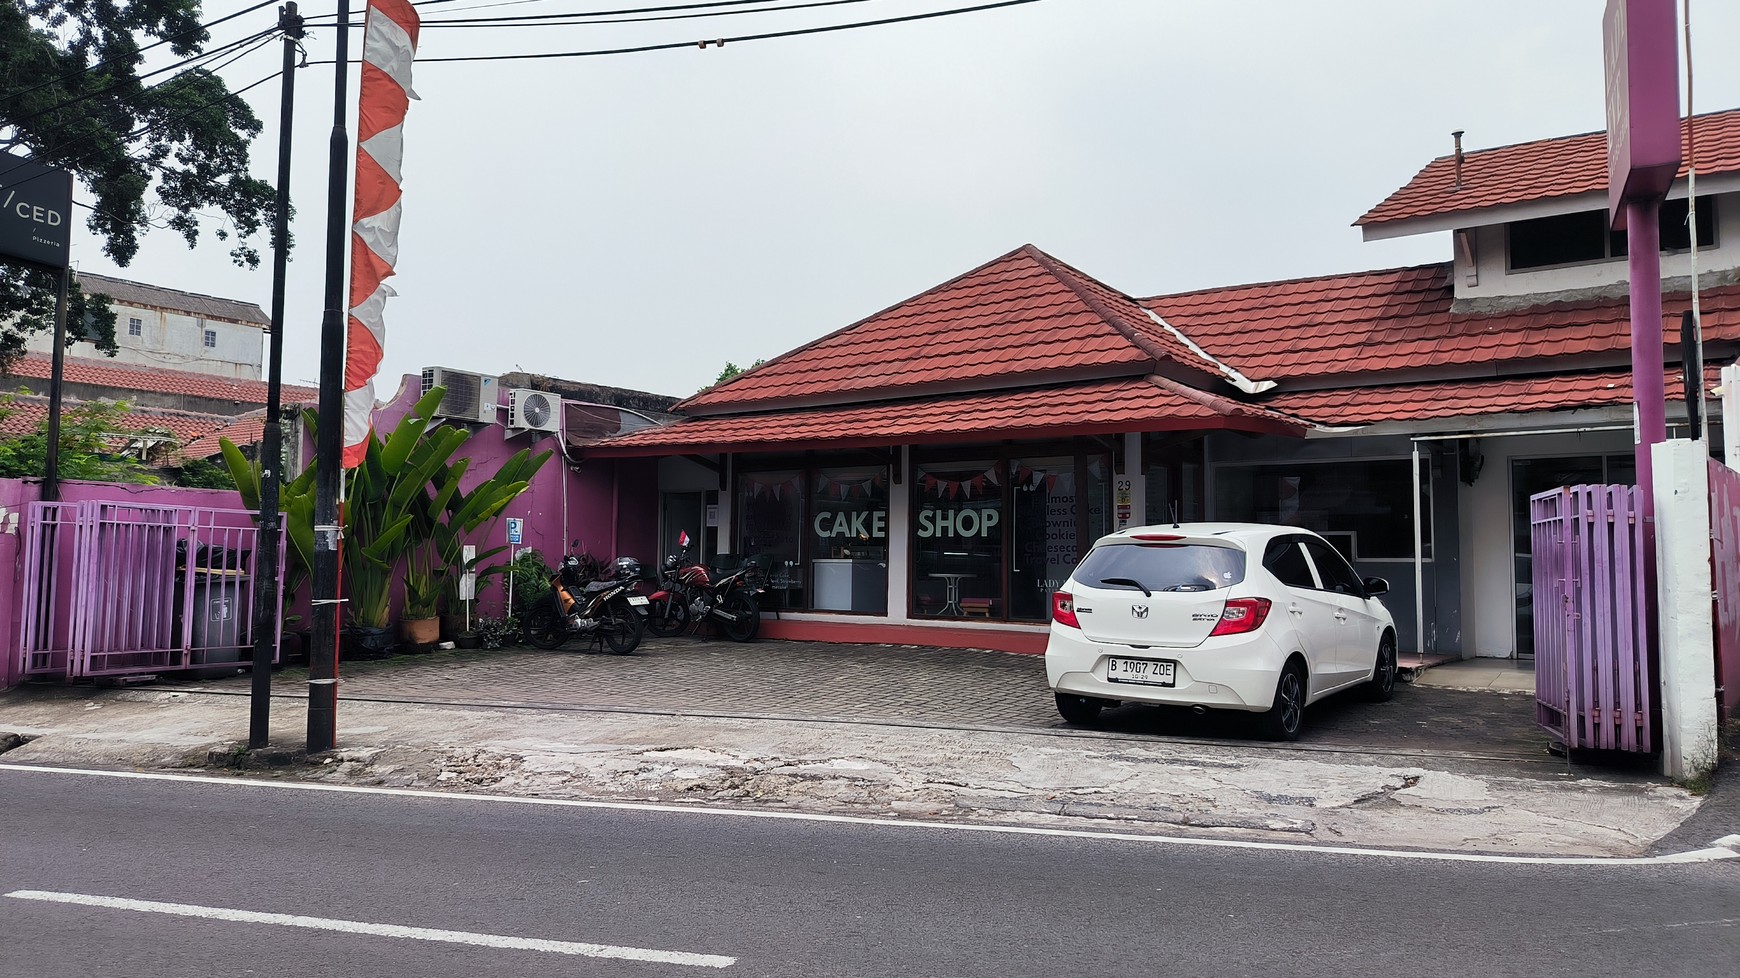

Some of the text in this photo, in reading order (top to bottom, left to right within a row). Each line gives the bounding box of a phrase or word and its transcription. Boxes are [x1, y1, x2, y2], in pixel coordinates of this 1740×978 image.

[32, 235, 60, 248] pizzeria
[1117, 480, 1131, 491] 29
[814, 511, 886, 538] CAKE
[917, 508, 999, 538] SHOP
[1037, 578, 1059, 588] LADY
[602, 585, 625, 602] HONDA
[1110, 659, 1173, 676] B 1907 ZOE
